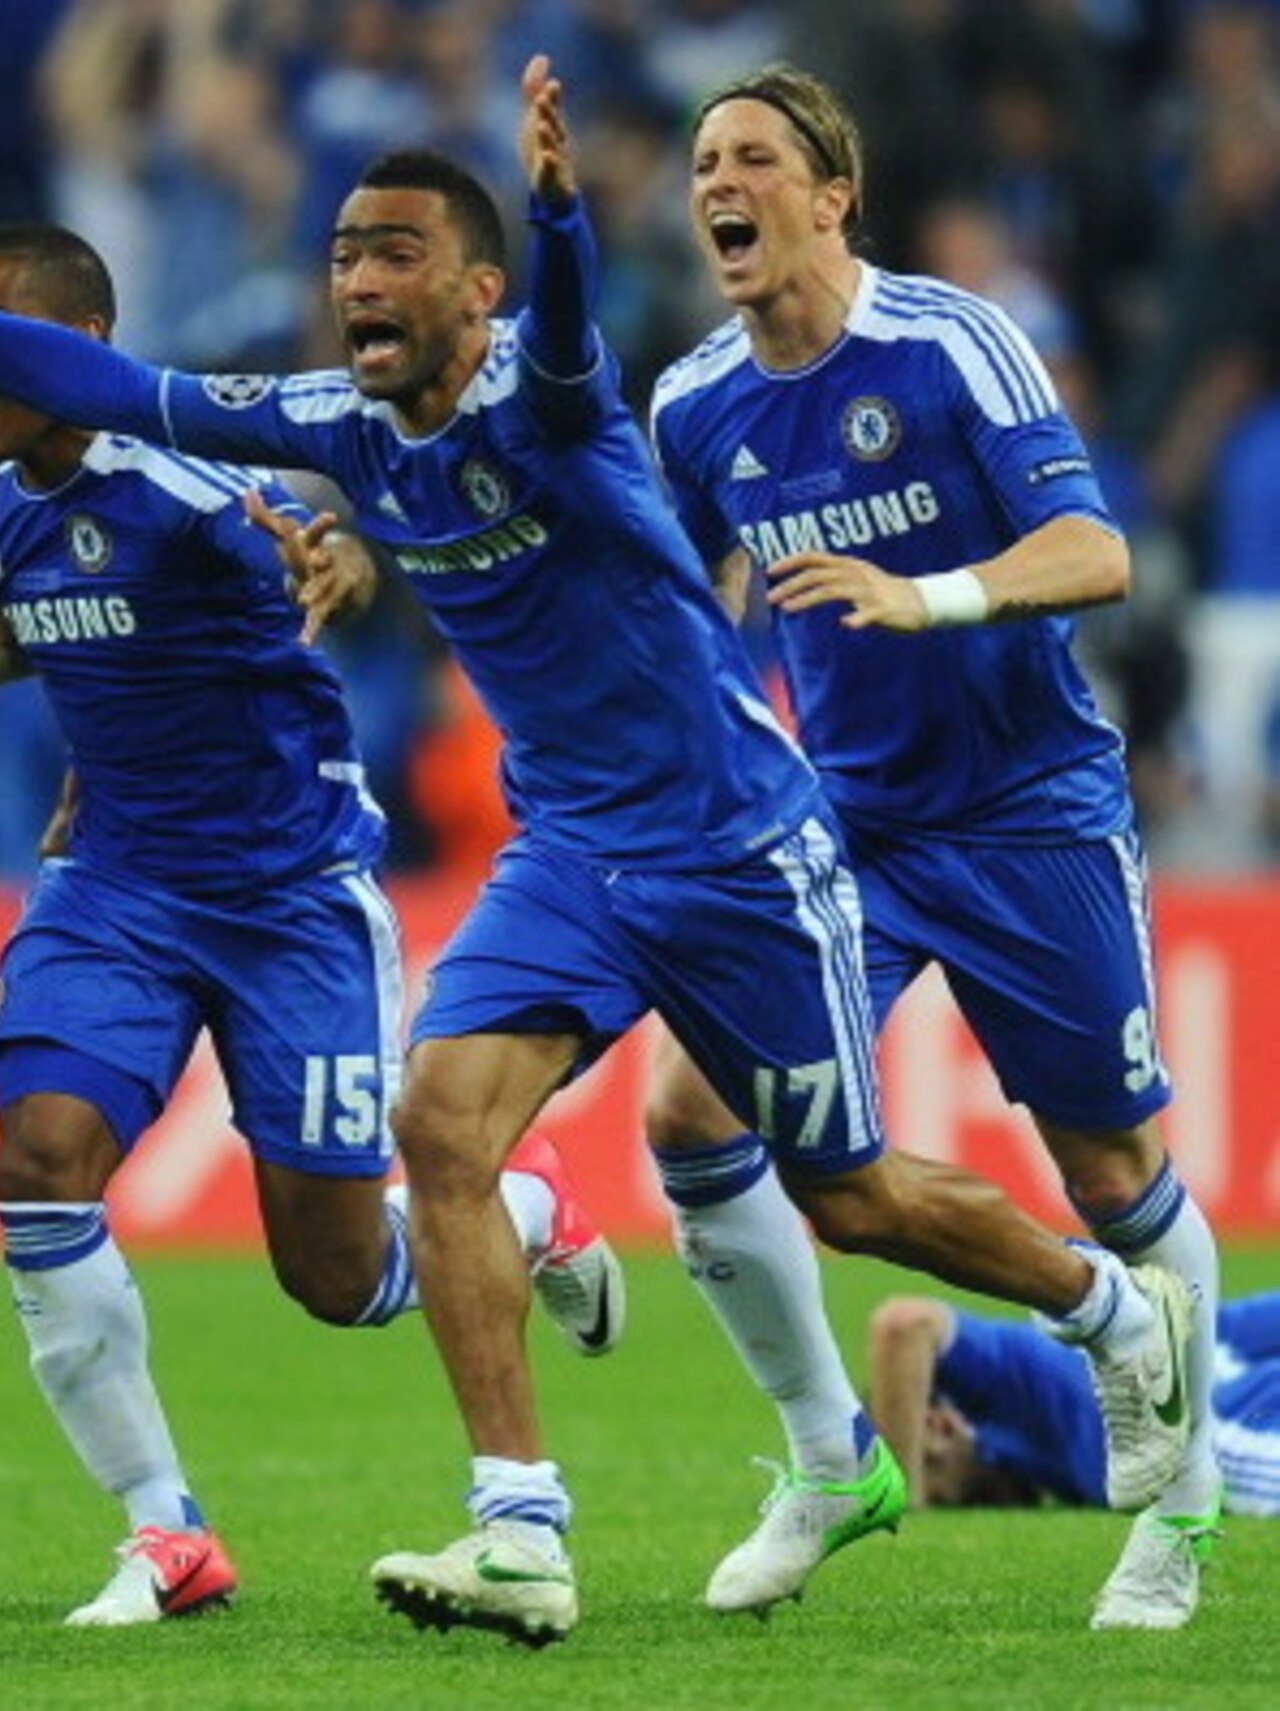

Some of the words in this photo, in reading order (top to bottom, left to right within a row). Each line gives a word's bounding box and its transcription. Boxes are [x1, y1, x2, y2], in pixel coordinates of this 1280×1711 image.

[739, 481, 941, 566] SAMSUNG
[2, 596, 136, 645] MSUNG
[1122, 1004, 1153, 1094] 9
[301, 1055, 376, 1146] 15
[754, 1058, 837, 1149] 17
